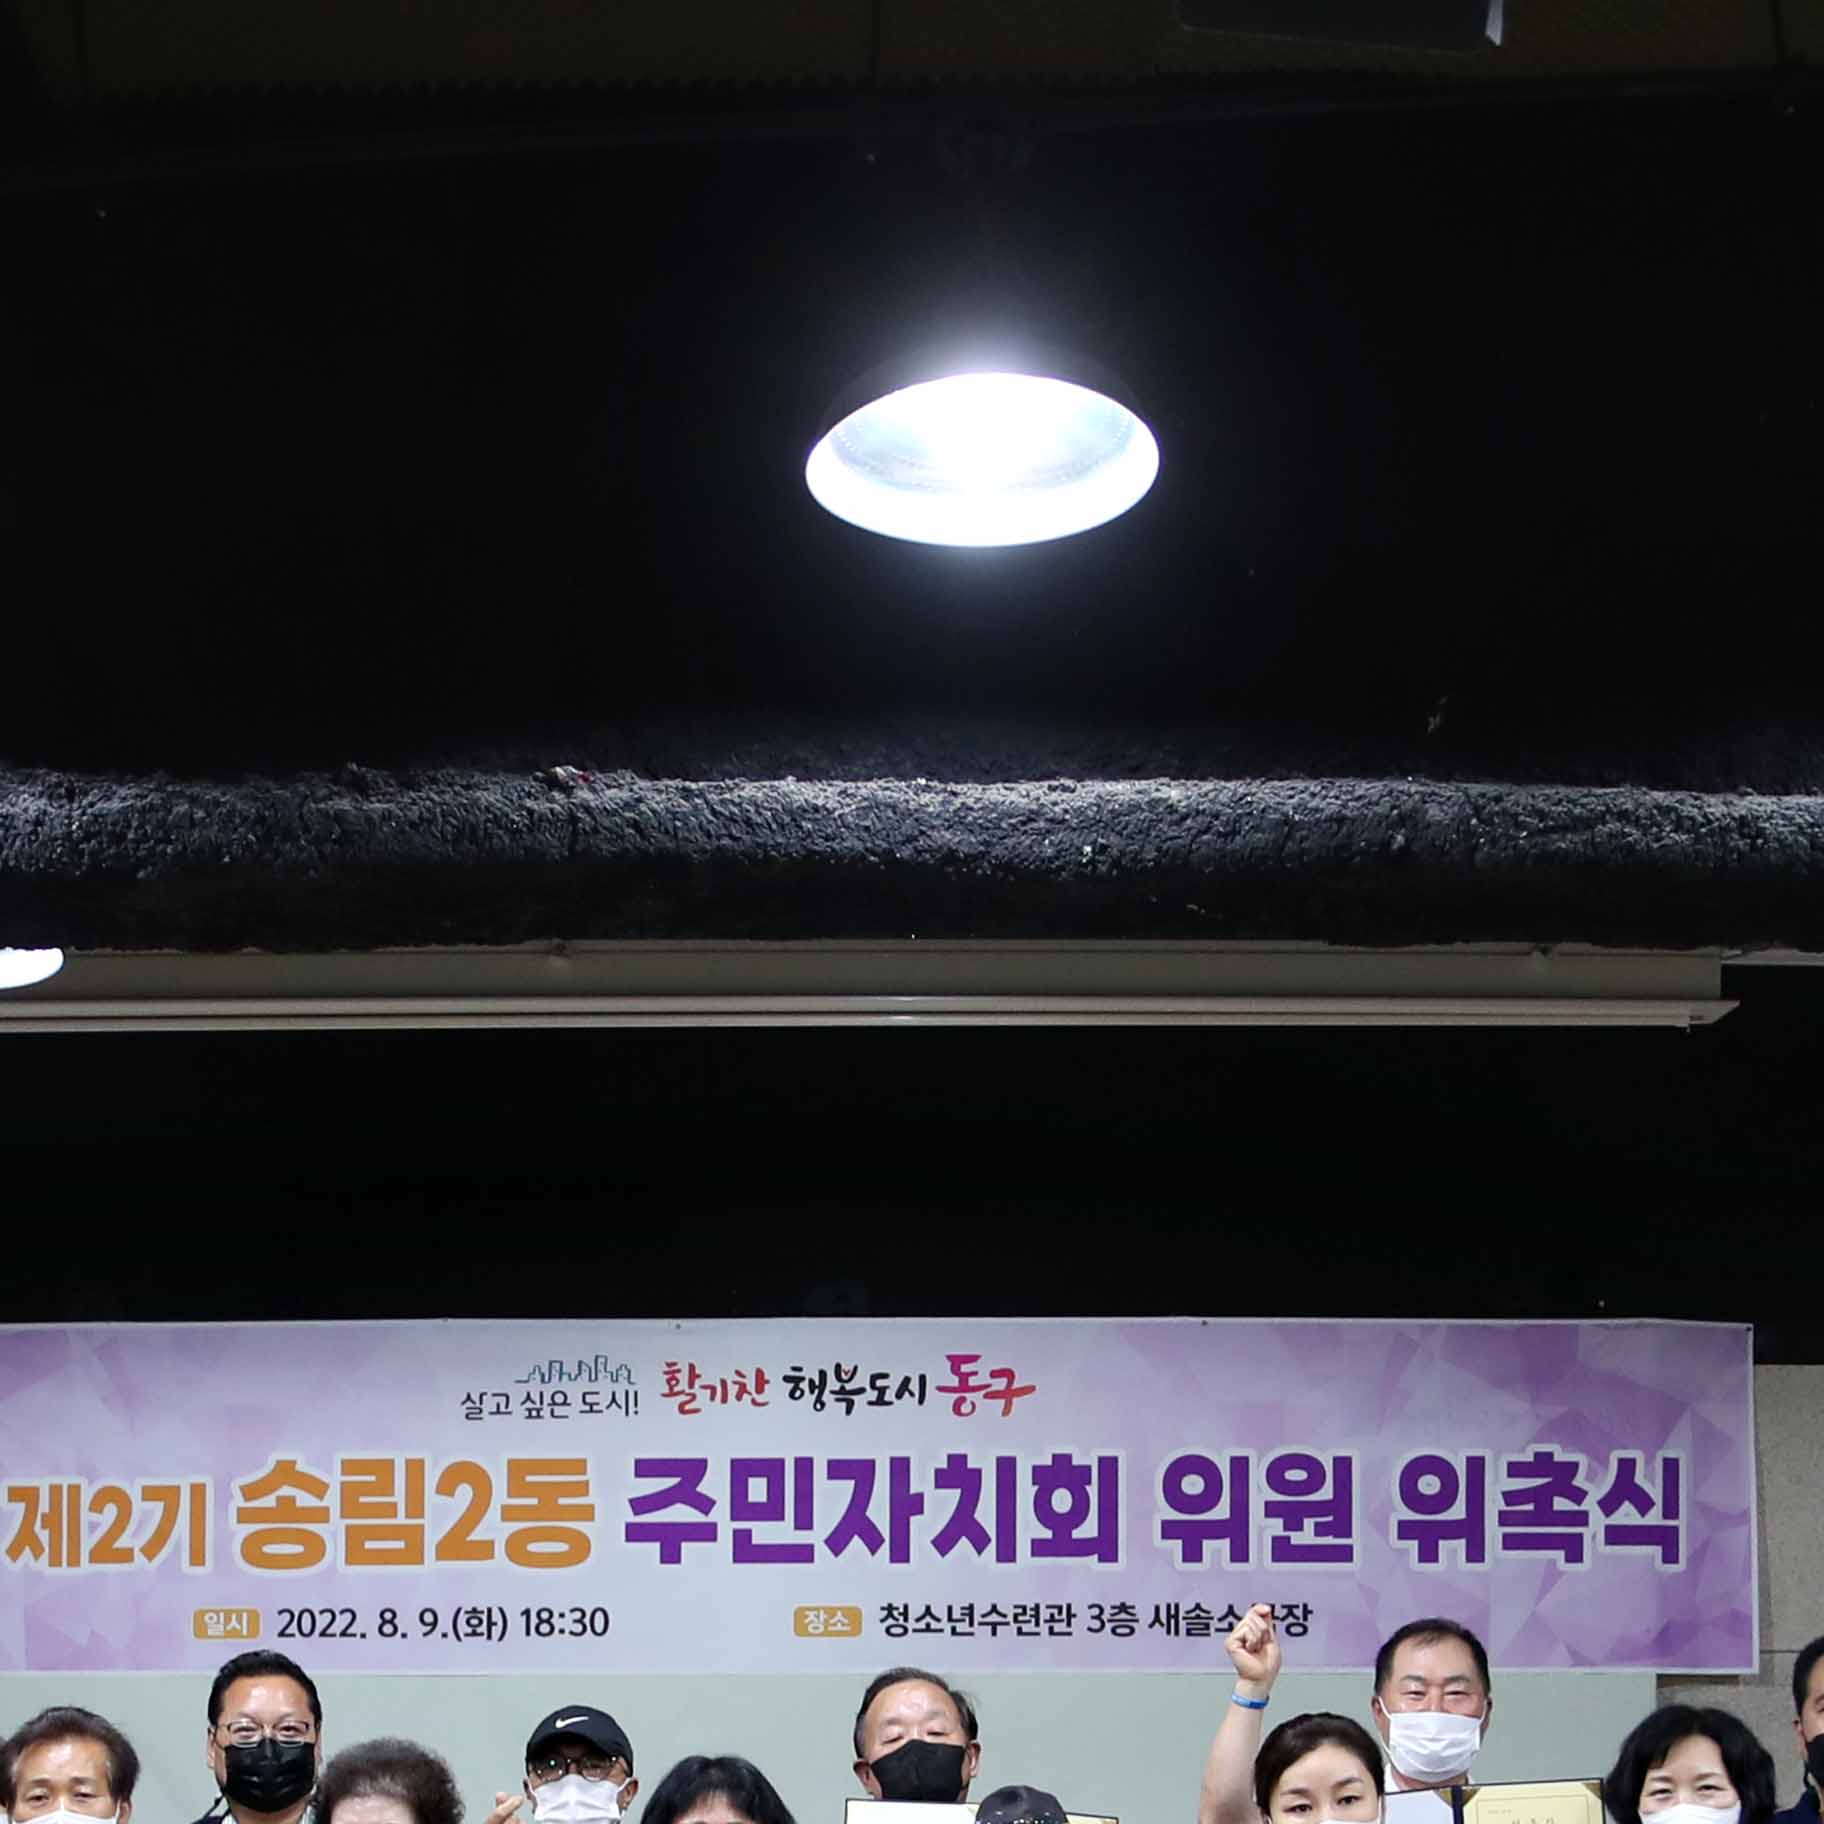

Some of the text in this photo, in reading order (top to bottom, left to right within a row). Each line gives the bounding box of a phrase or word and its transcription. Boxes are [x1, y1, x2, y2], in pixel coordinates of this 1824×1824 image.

[660, 1354, 1036, 1418] 활기찬 행복도시 동구
[461, 1389, 639, 1421] 살고 싶은 도시!
[5, 1450, 1680, 1570] 제2기 송림2동 주민자치회 위원 위촉식
[203, 1611, 249, 1636] 일시
[277, 1608, 367, 1638] 2022.
[520, 1607, 610, 1638] 18:30
[804, 1602, 1313, 1638] 장소 청소년수련관 3층 새솔소장
